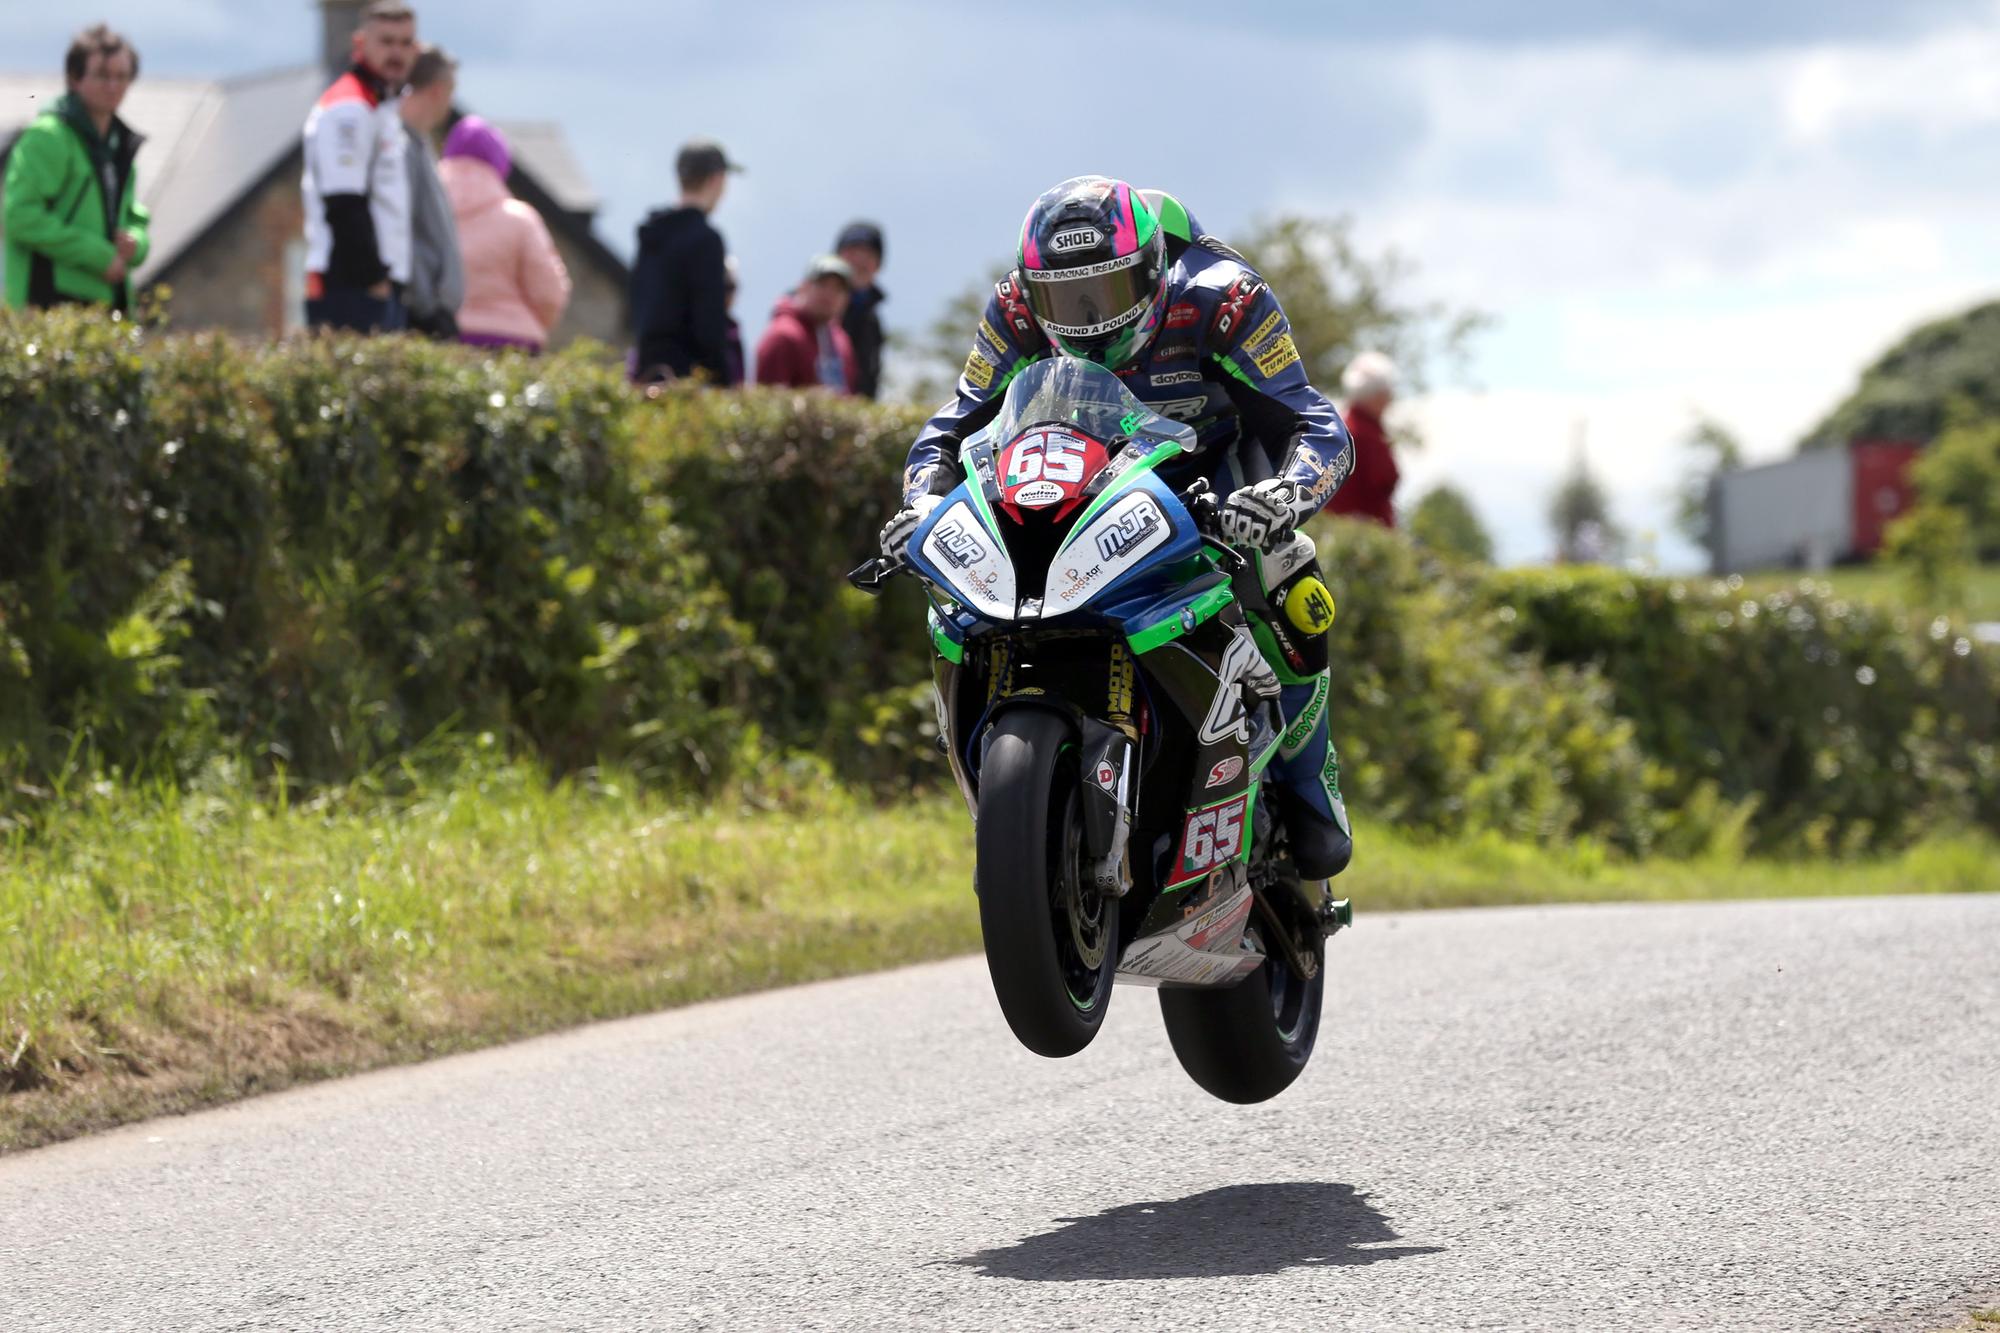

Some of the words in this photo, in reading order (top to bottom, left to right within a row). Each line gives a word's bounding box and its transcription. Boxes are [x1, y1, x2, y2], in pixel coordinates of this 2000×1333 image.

[1055, 231, 1095, 249] SHOEI
[1031, 271, 1052, 280] ROAD
[1053, 267, 1089, 280] RACING
[1092, 257, 1132, 274] IRELAND
[1046, 322, 1089, 335] AROUND
[1091, 325, 1100, 334] A
[1102, 307, 1139, 331] POUND
[1250, 312, 1279, 345] DUNLOP
[1153, 372, 1201, 384] daytona
[1006, 432, 1086, 487] 65
[934, 520, 986, 568] MJR
[1096, 501, 1159, 561] MJR
[968, 569, 1000, 602] Roadstar
[1060, 564, 1101, 600] Roadstar
[1283, 676, 1328, 749] daytona
[1183, 800, 1244, 873] 65
